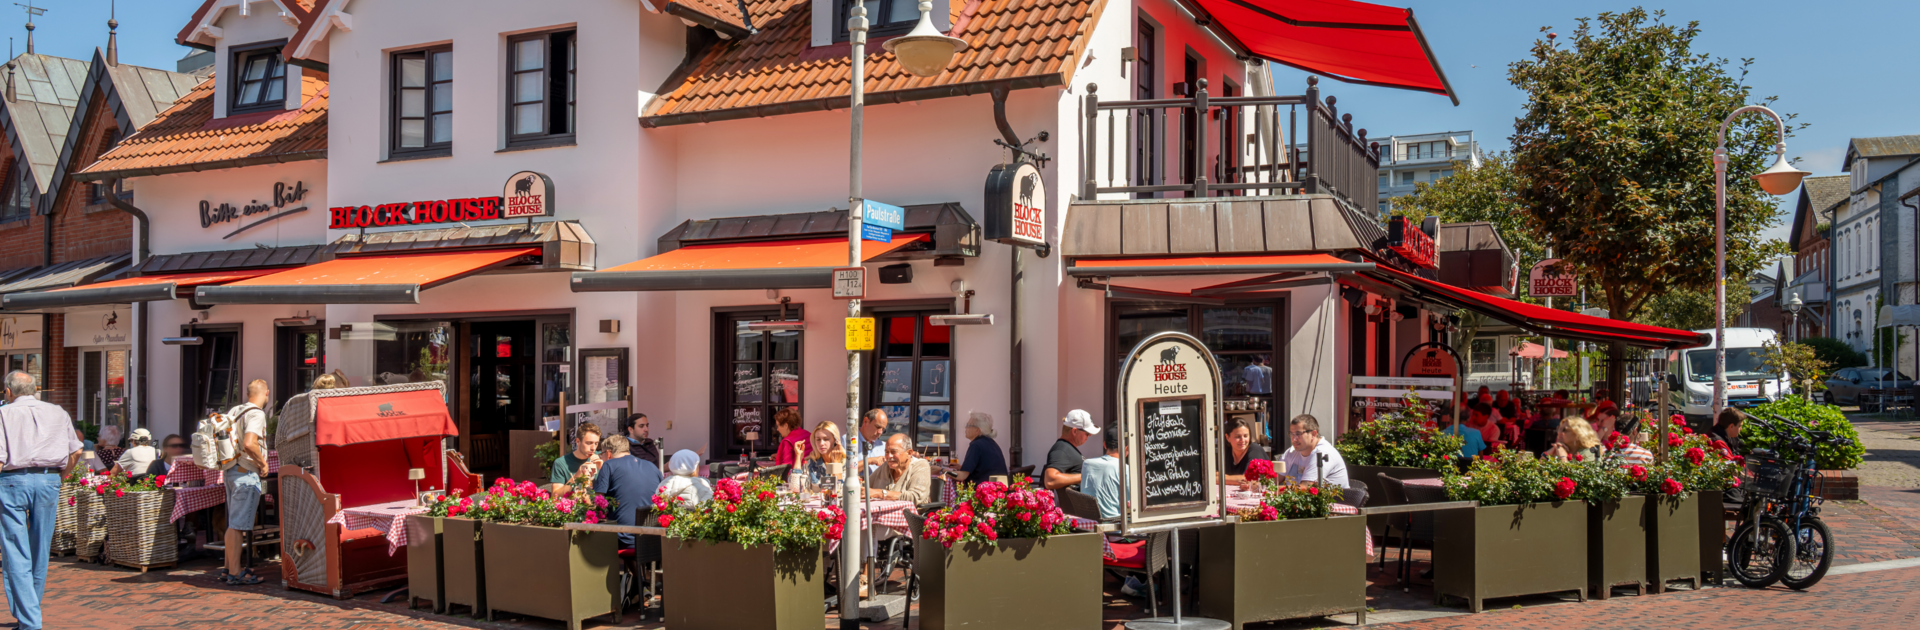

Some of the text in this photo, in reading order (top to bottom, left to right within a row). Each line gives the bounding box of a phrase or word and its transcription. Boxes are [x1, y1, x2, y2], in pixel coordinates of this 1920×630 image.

[199, 181, 308, 228] Bitte ein Bit
[508, 195, 542, 206] BLOCK
[329, 196, 499, 229] BLOCK HOUSE
[508, 204, 542, 216] HOUSE
[866, 204, 901, 224] Paulstraße
[1014, 203, 1042, 224] BLOCK
[1014, 219, 1042, 240] HOUSE
[1534, 278, 1573, 286] BLOCK
[1534, 286, 1573, 294] HOUSE
[1154, 363, 1187, 373] BLOCK
[1154, 372, 1187, 382] HOUSE
[1154, 382, 1188, 394] Heute
